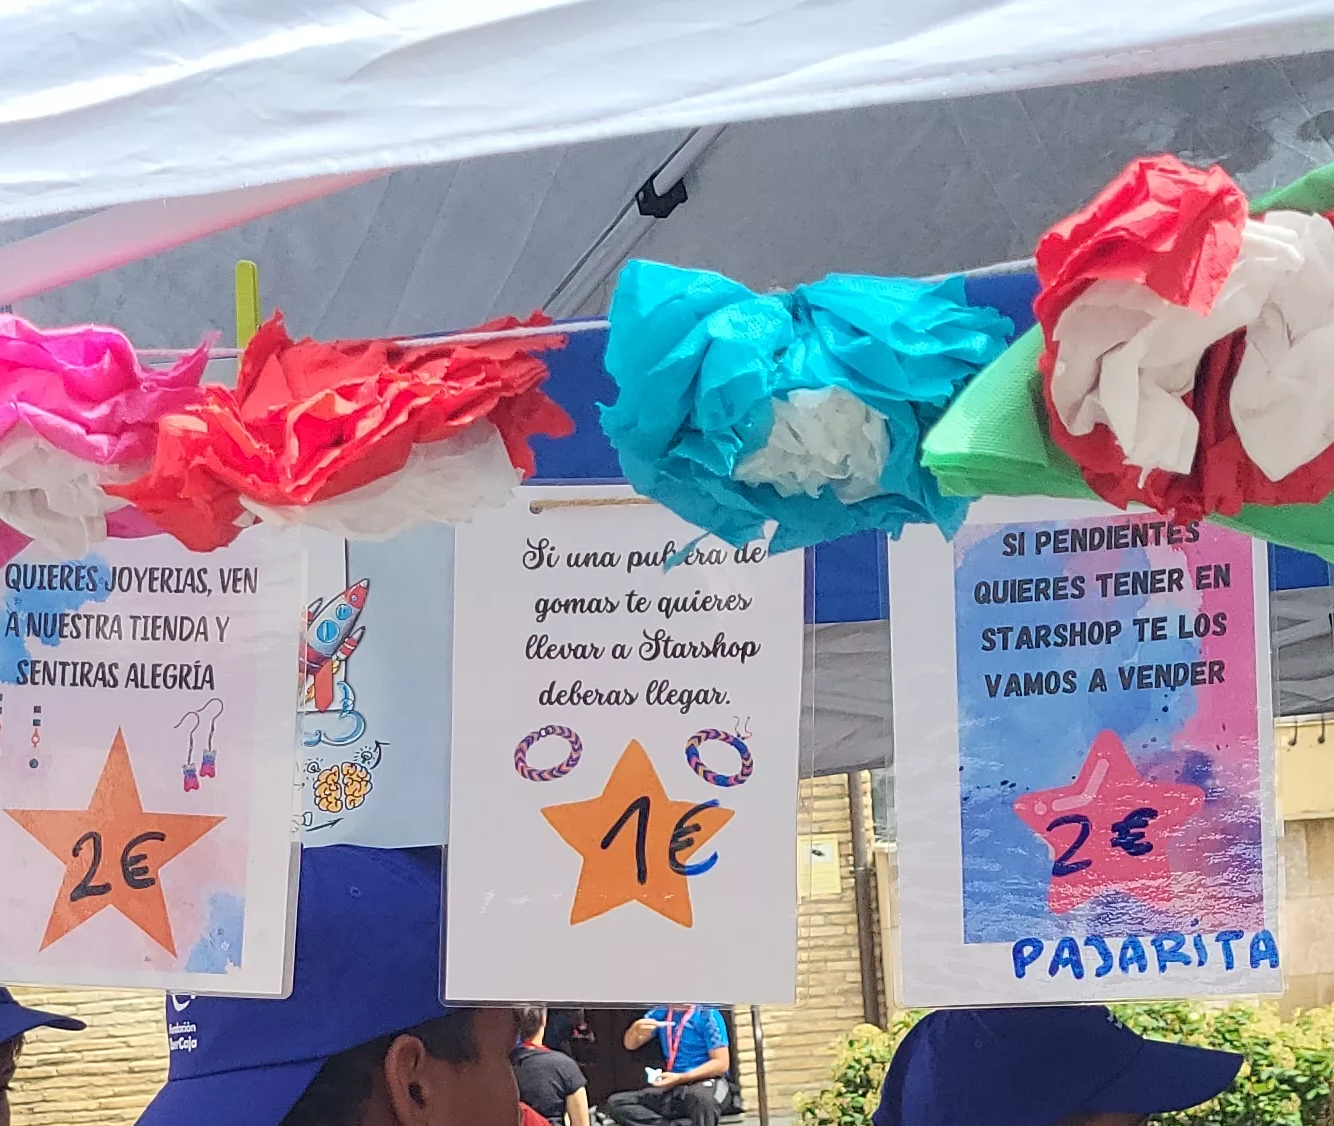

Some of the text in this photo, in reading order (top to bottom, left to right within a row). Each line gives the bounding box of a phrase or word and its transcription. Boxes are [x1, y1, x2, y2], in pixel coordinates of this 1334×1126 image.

[522, 537, 767, 574] Si una pulera de
[1002, 520, 1200, 557] SI PENDIENTES
[5, 563, 98, 593] QUIERES
[105, 565, 213, 598] JOYERIAS,
[219, 566, 259, 595] VEN
[974, 563, 1231, 605] QUIERES TENER EN
[534, 589, 753, 623] gomas te quieres
[5, 611, 230, 643] A NUESTRA TIENDA Y
[981, 611, 1228, 652] STARSHOP TE LOS
[525, 628, 761, 664] llevar a Starshop
[17, 659, 215, 691] SENTIRAS ALEGRÍA
[984, 659, 1225, 699] VAMOS A VENDER
[538, 679, 731, 714] deberas llegar.
